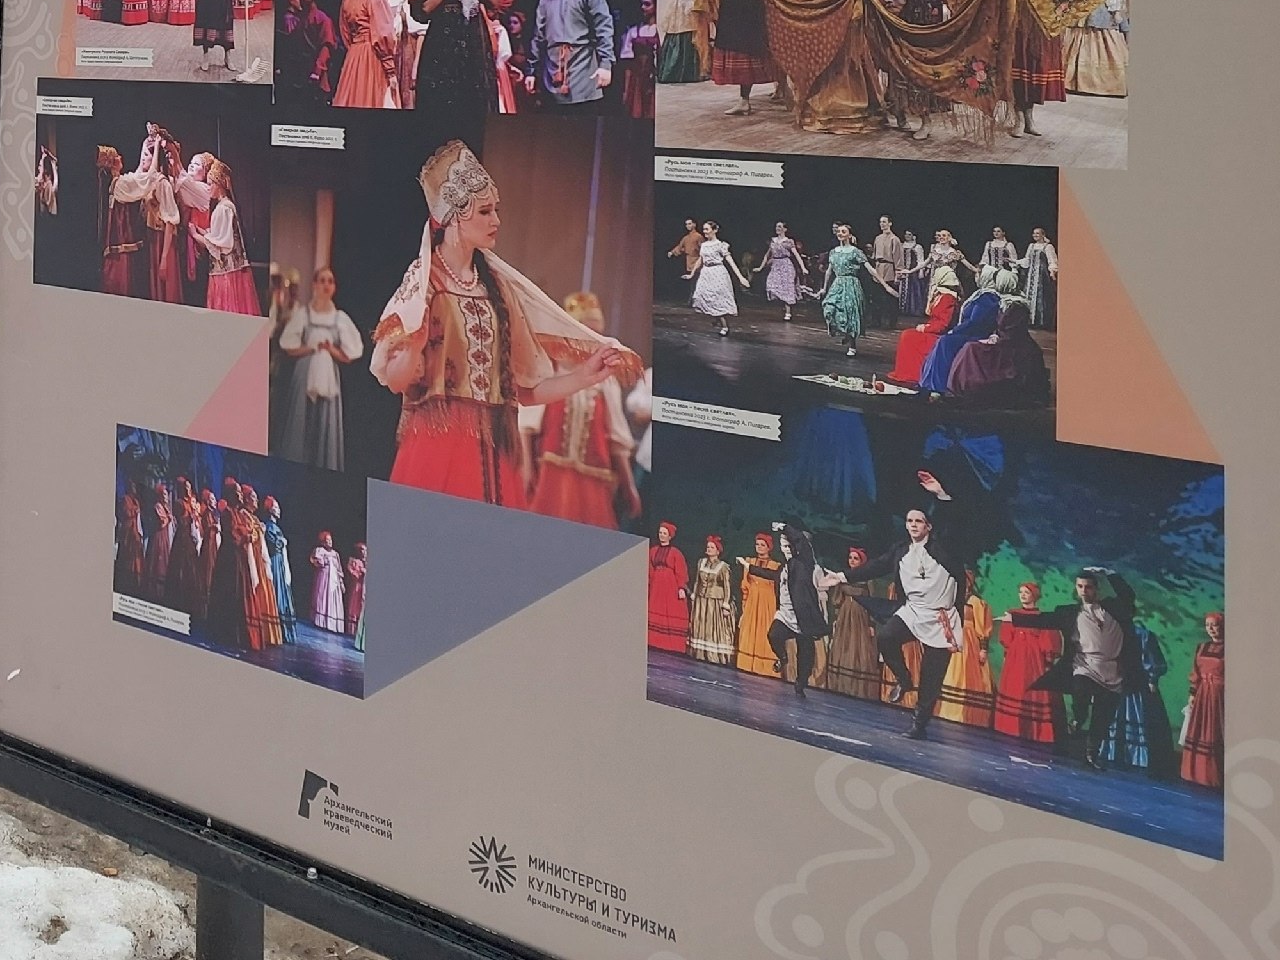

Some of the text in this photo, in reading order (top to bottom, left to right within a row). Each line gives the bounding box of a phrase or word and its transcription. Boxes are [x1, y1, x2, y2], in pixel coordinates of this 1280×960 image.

[323, 796, 393, 829] Архангельский
[323, 808, 393, 841] краеведческий
[323, 819, 351, 835] музей
[528, 854, 627, 902] МИНИСТЕРСТВО
[527, 894, 627, 939] Архангельской области
[528, 875, 677, 943] КУЛЬТУРЫ И ТУРИЗМА
